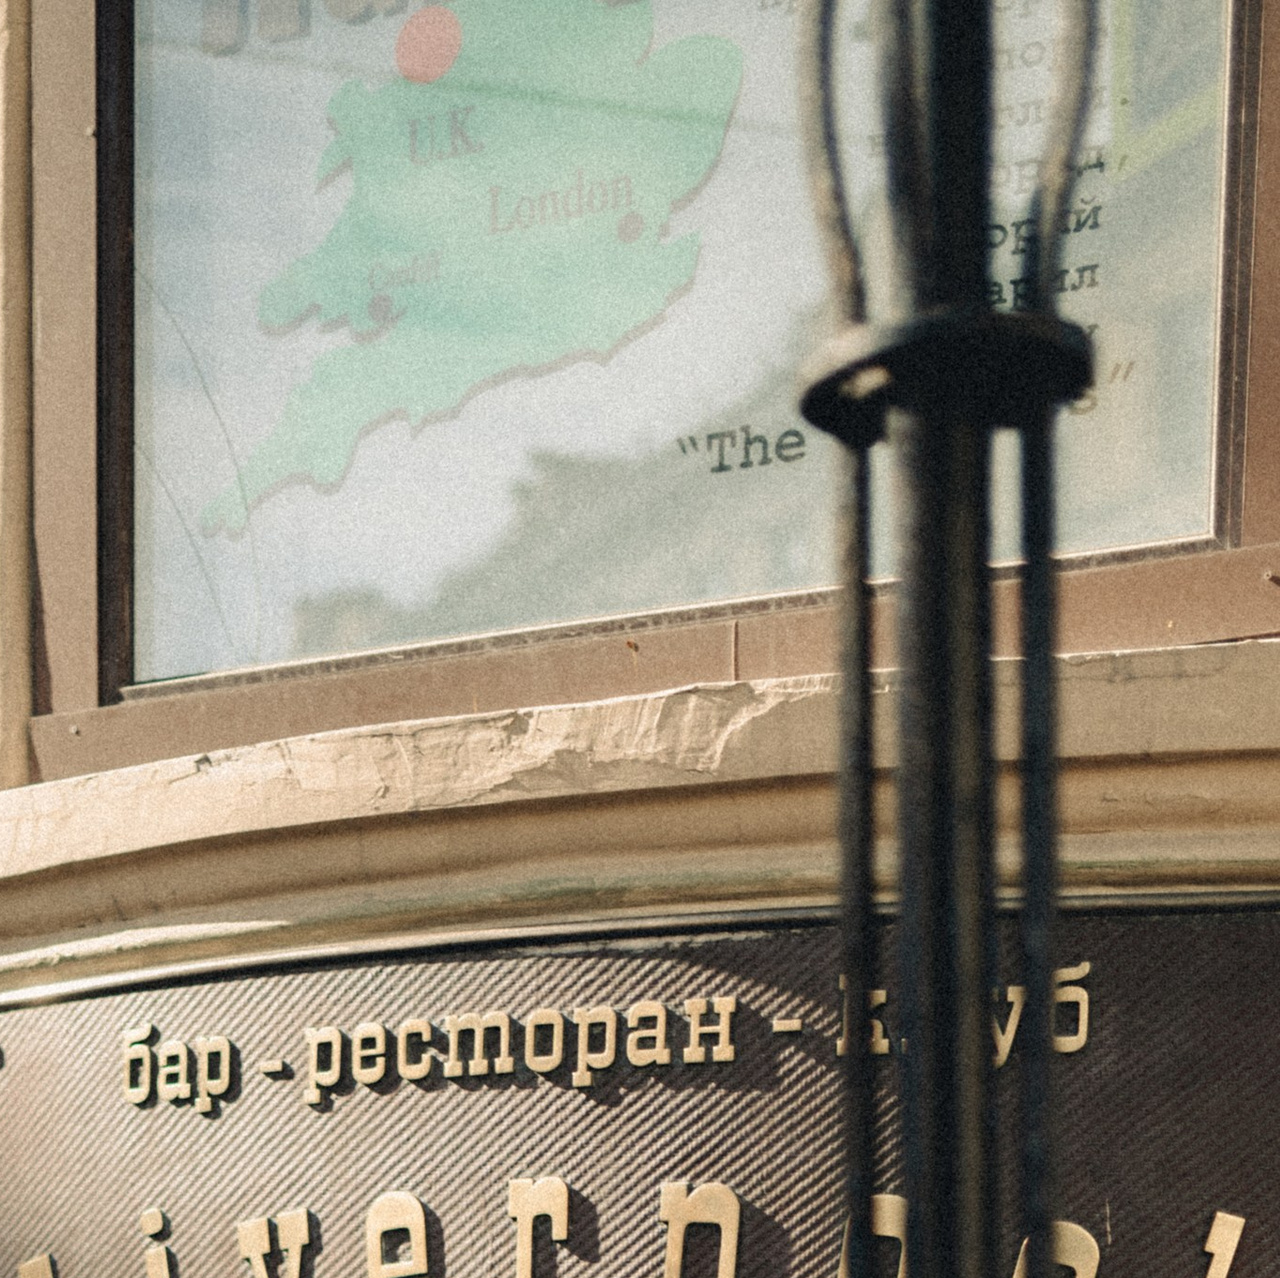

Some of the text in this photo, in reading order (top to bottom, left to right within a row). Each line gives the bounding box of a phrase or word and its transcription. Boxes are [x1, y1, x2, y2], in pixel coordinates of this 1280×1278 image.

[487, 168, 634, 236] London
[122, 1023, 231, 1112] бар
[304, 996, 737, 1104] ресторан
[835, 959, 1092, 1070] куб
